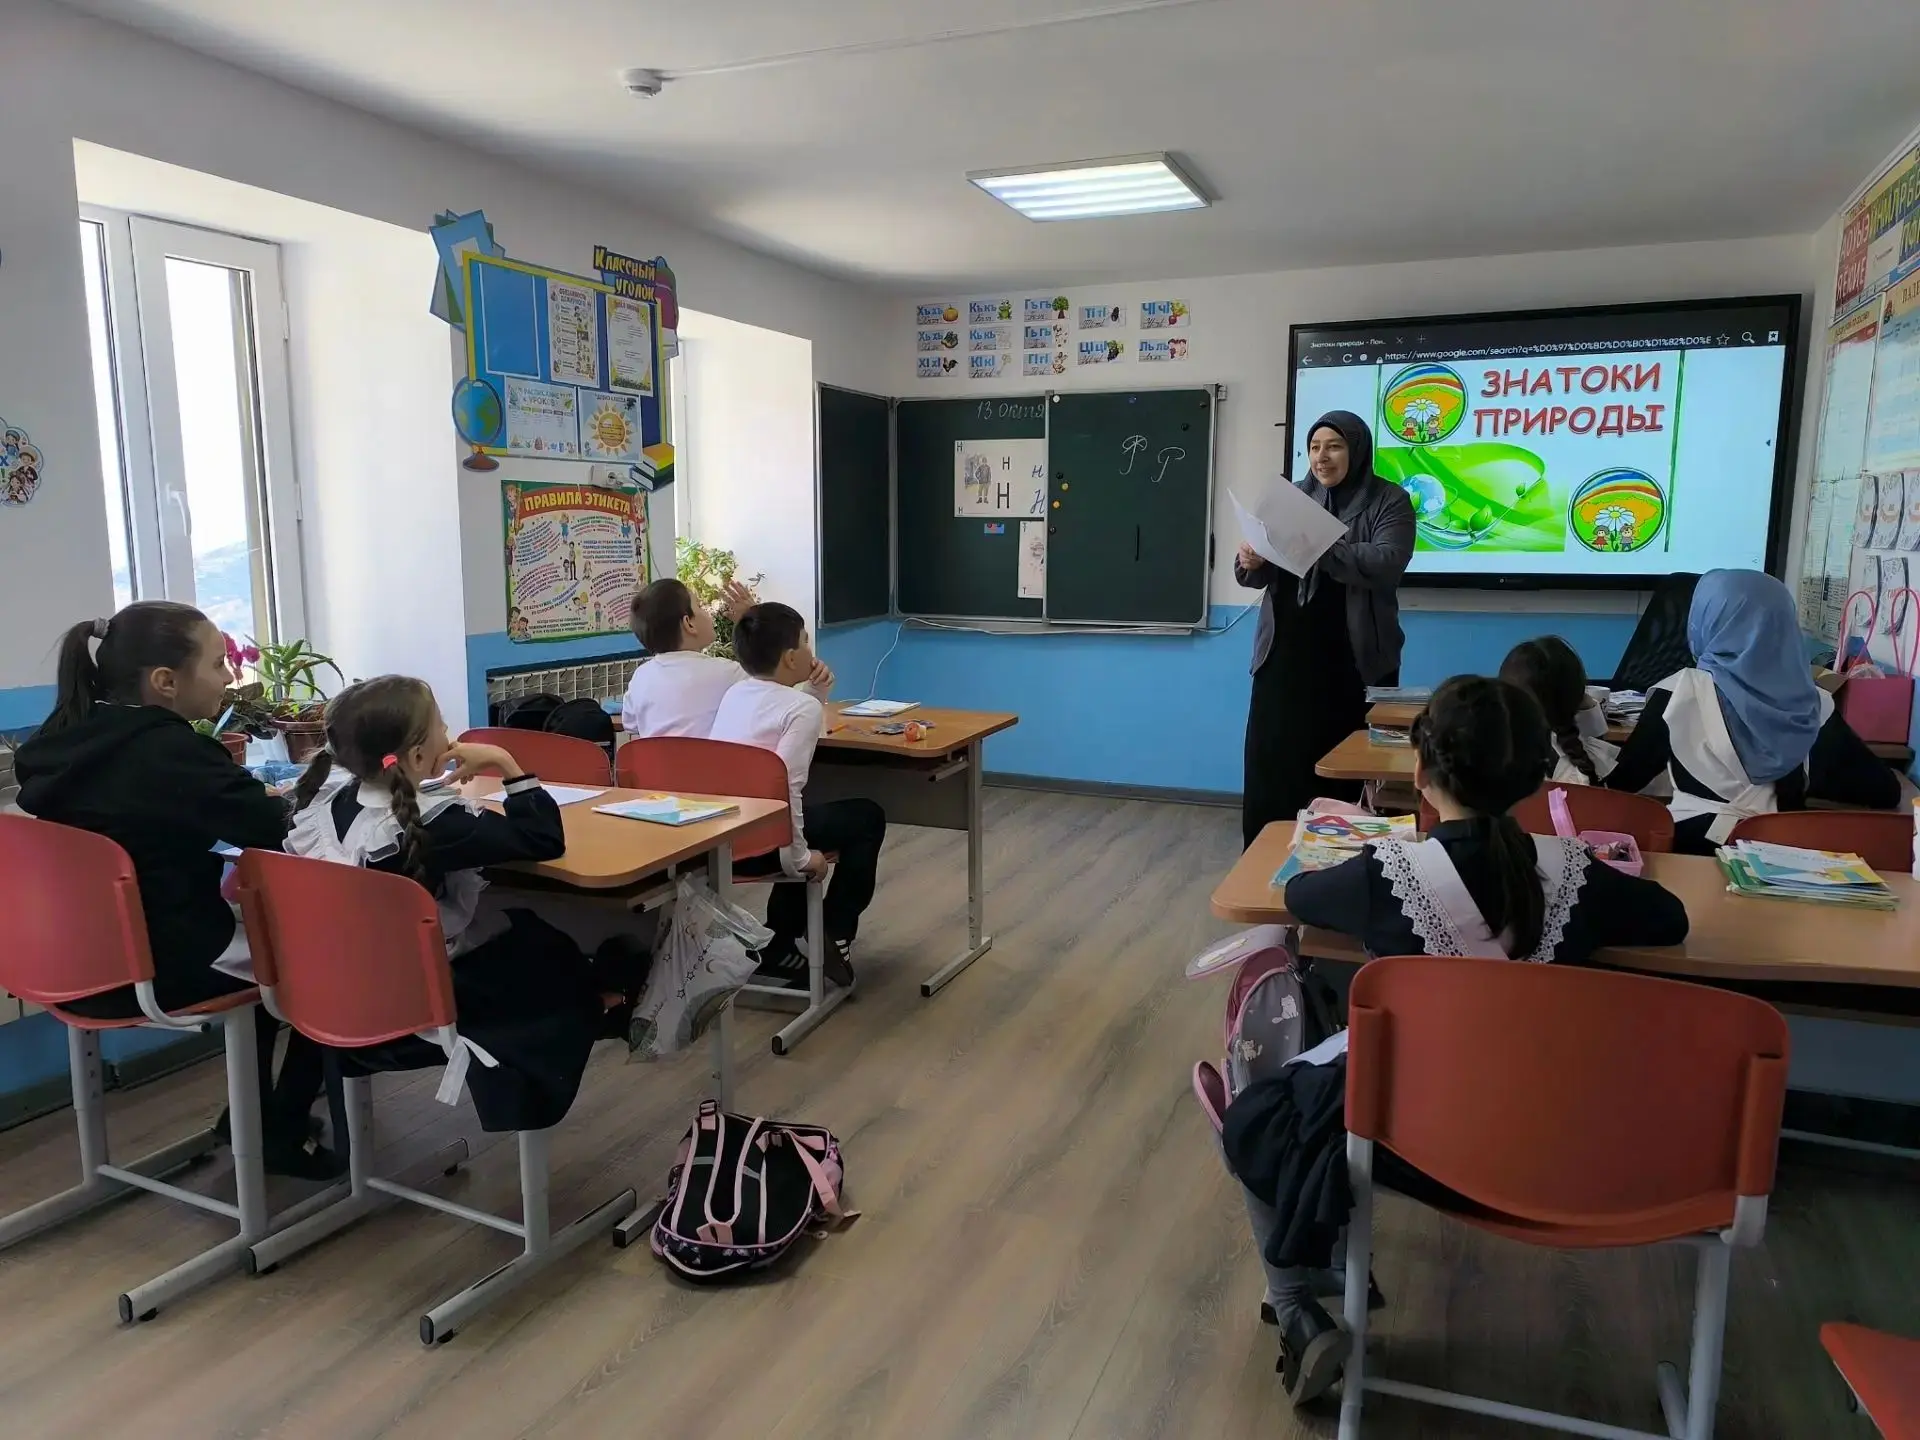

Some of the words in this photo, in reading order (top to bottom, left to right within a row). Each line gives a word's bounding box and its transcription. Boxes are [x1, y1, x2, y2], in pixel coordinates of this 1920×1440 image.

[1481, 362, 1661, 398] ЗНАТОКИ
[977, 400, 993, 420] 13
[1473, 404, 1666, 438] ПРИРОДЫ
[1002, 456, 1010, 470] Н
[524, 490, 582, 511] ПРАВИЛА
[584, 492, 631, 514] ЭТИКЕТА
[997, 482, 1010, 509] Н
